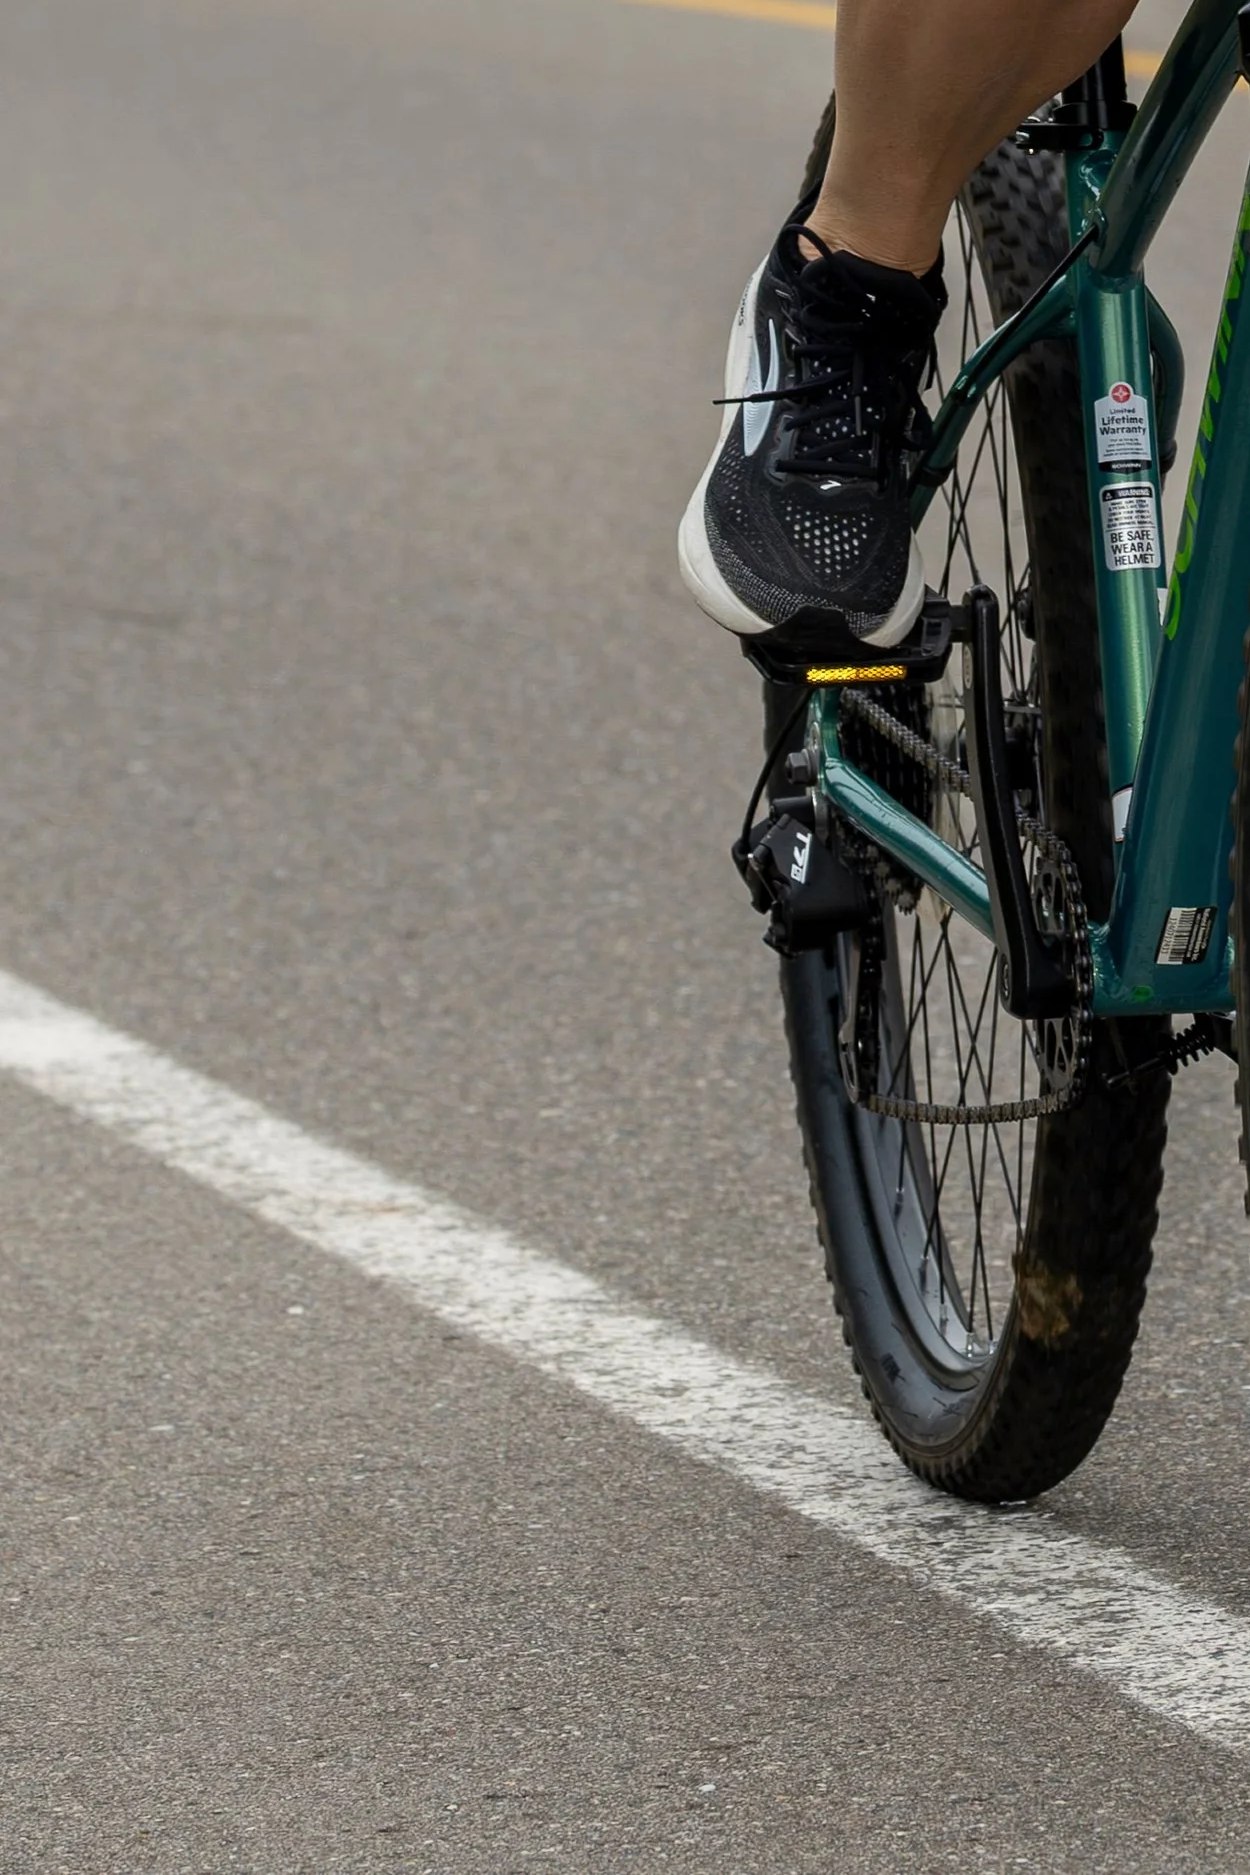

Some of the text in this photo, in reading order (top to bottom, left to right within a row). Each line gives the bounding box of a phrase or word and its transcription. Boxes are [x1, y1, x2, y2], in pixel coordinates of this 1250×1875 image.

[1101, 415, 1144, 427] Lifetime
[1099, 425, 1147, 437] Warranty
[1110, 532, 1125, 544] BE
[1111, 541, 1154, 556] WEAR A
[1114, 553, 1155, 567] HELMET
